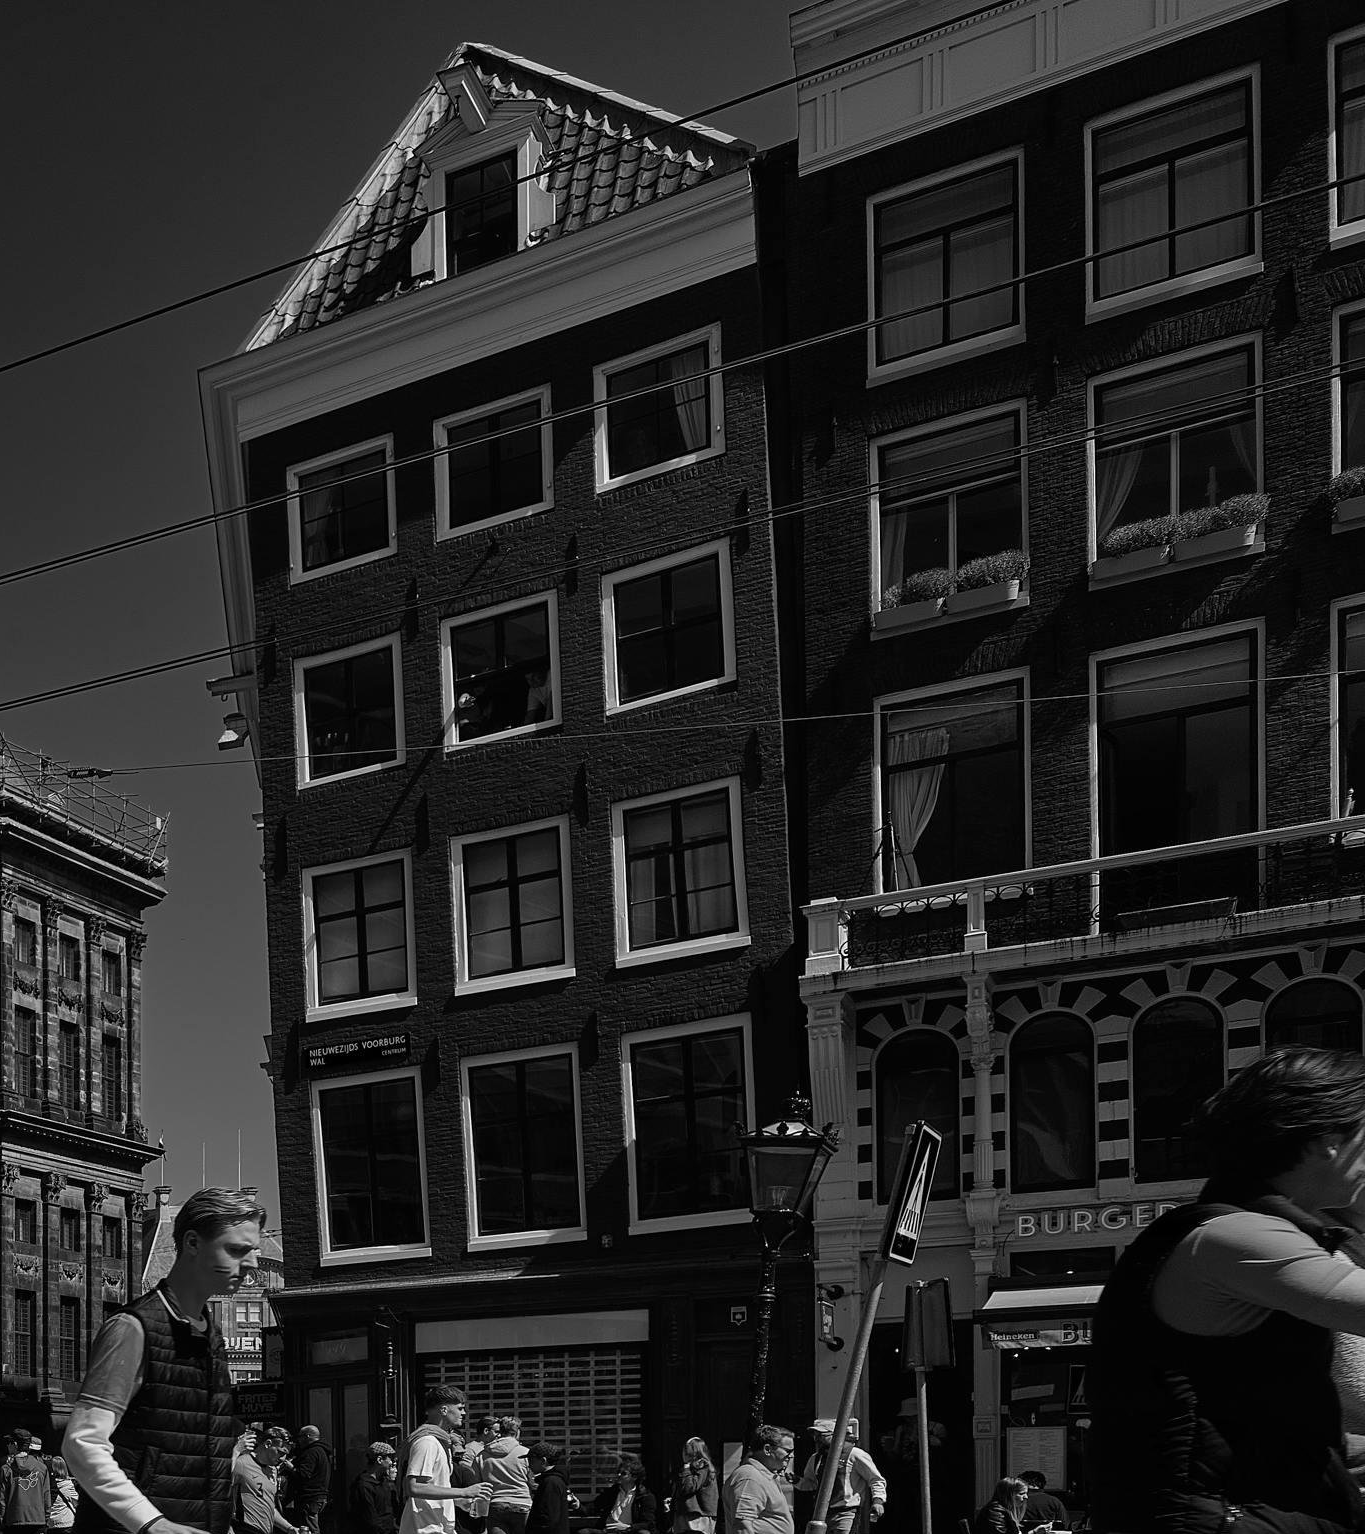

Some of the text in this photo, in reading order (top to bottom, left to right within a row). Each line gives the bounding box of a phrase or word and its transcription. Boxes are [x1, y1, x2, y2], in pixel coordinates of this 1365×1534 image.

[309, 1035, 406, 1058] NIEUWEZIJDS VOORBURG
[381, 1047, 407, 1056] CENTRUM
[310, 1058, 326, 1066] WAL
[990, 1331, 1036, 1342] Heineken
